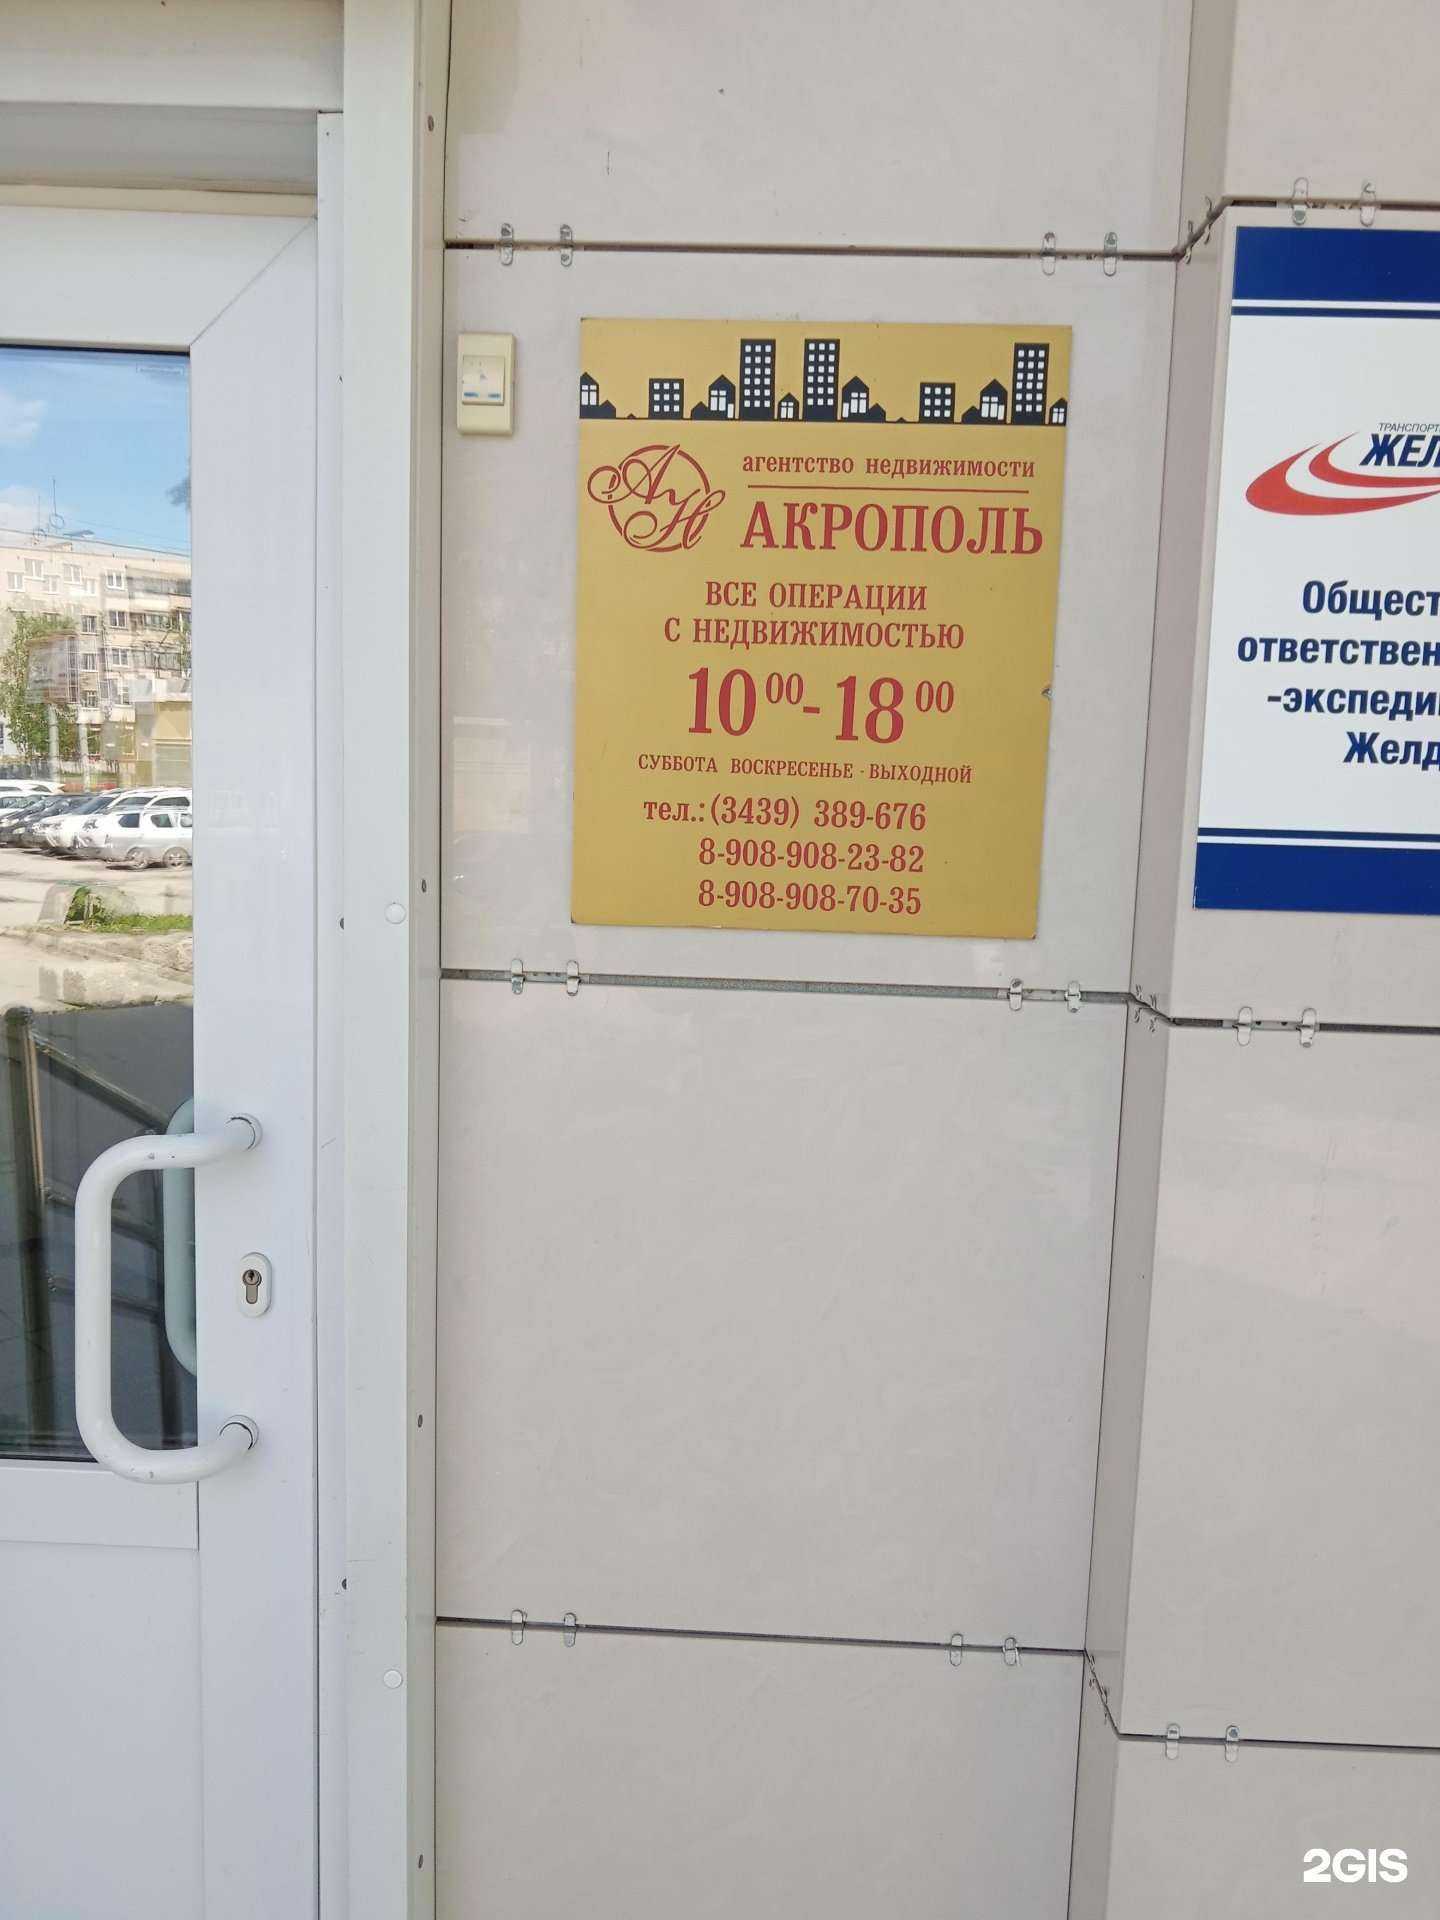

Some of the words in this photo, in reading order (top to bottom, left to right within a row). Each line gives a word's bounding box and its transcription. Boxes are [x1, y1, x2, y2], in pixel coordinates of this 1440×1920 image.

[1379, 422, 1440, 433] ТРАНСПОРТ
[742, 455, 854, 474] агентство
[866, 459, 1035, 479] недвижимости
[740, 500, 1044, 555] АКРОПОЛЬ
[705, 581, 757, 608] ВСЕ
[768, 583, 928, 613] ОПЕРАЦИИ
[664, 617, 681, 642] С
[693, 618, 965, 650] НЕДВИЖИМОСТЬЮ
[1267, 687, 1440, 722] -экспеди
[638, 754, 718, 774] СУББОТА
[730, 758, 853, 780] ВОСКРЕСЕНЬЕ
[869, 763, 973, 785] ВЫХОДНОЙ
[814, 799, 926, 831] 389-676
[699, 837, 924, 873] 8-908-908-23-82
[698, 879, 922, 915] 8-908-908-70-35
